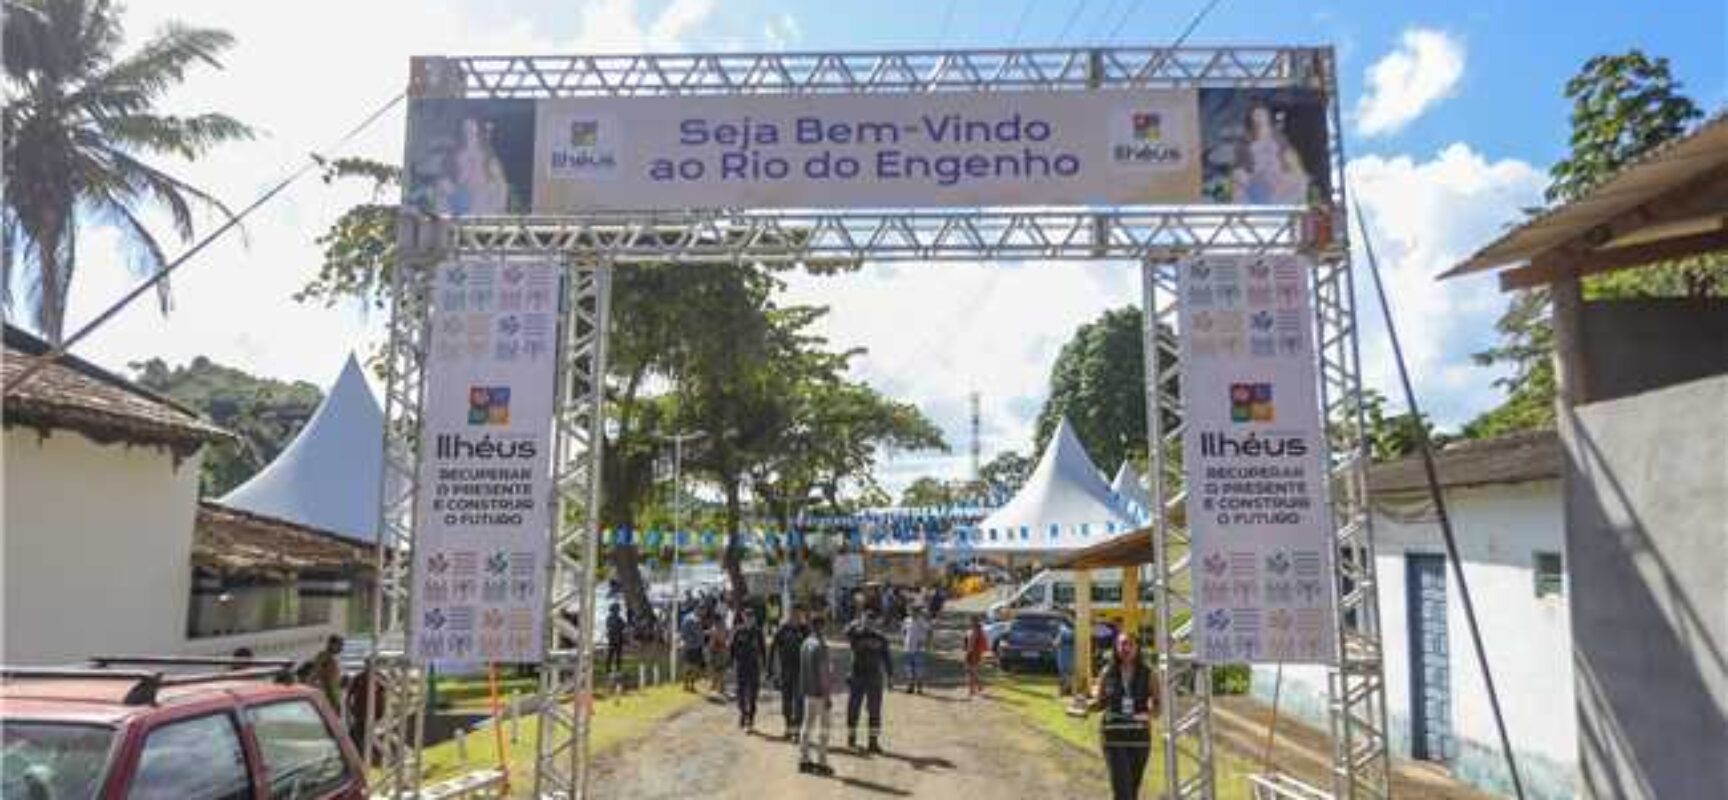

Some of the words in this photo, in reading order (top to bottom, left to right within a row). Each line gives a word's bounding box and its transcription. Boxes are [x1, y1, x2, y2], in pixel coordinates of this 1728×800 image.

[680, 117, 779, 149] Seja
[796, 113, 1051, 144] Bem-Vindo
[650, 158, 705, 181] ao
[721, 151, 790, 180] Rio
[804, 150, 860, 179] do
[876, 149, 1080, 186] Engenho
[437, 434, 537, 459] Ilhéus
[1200, 432, 1307, 457] Ilhéus
[436, 483, 449, 495] O
[1204, 483, 1218, 495] O
[433, 499, 444, 511] E
[1204, 499, 1214, 511] E
[443, 514, 457, 525] O
[1217, 513, 1229, 525] O
